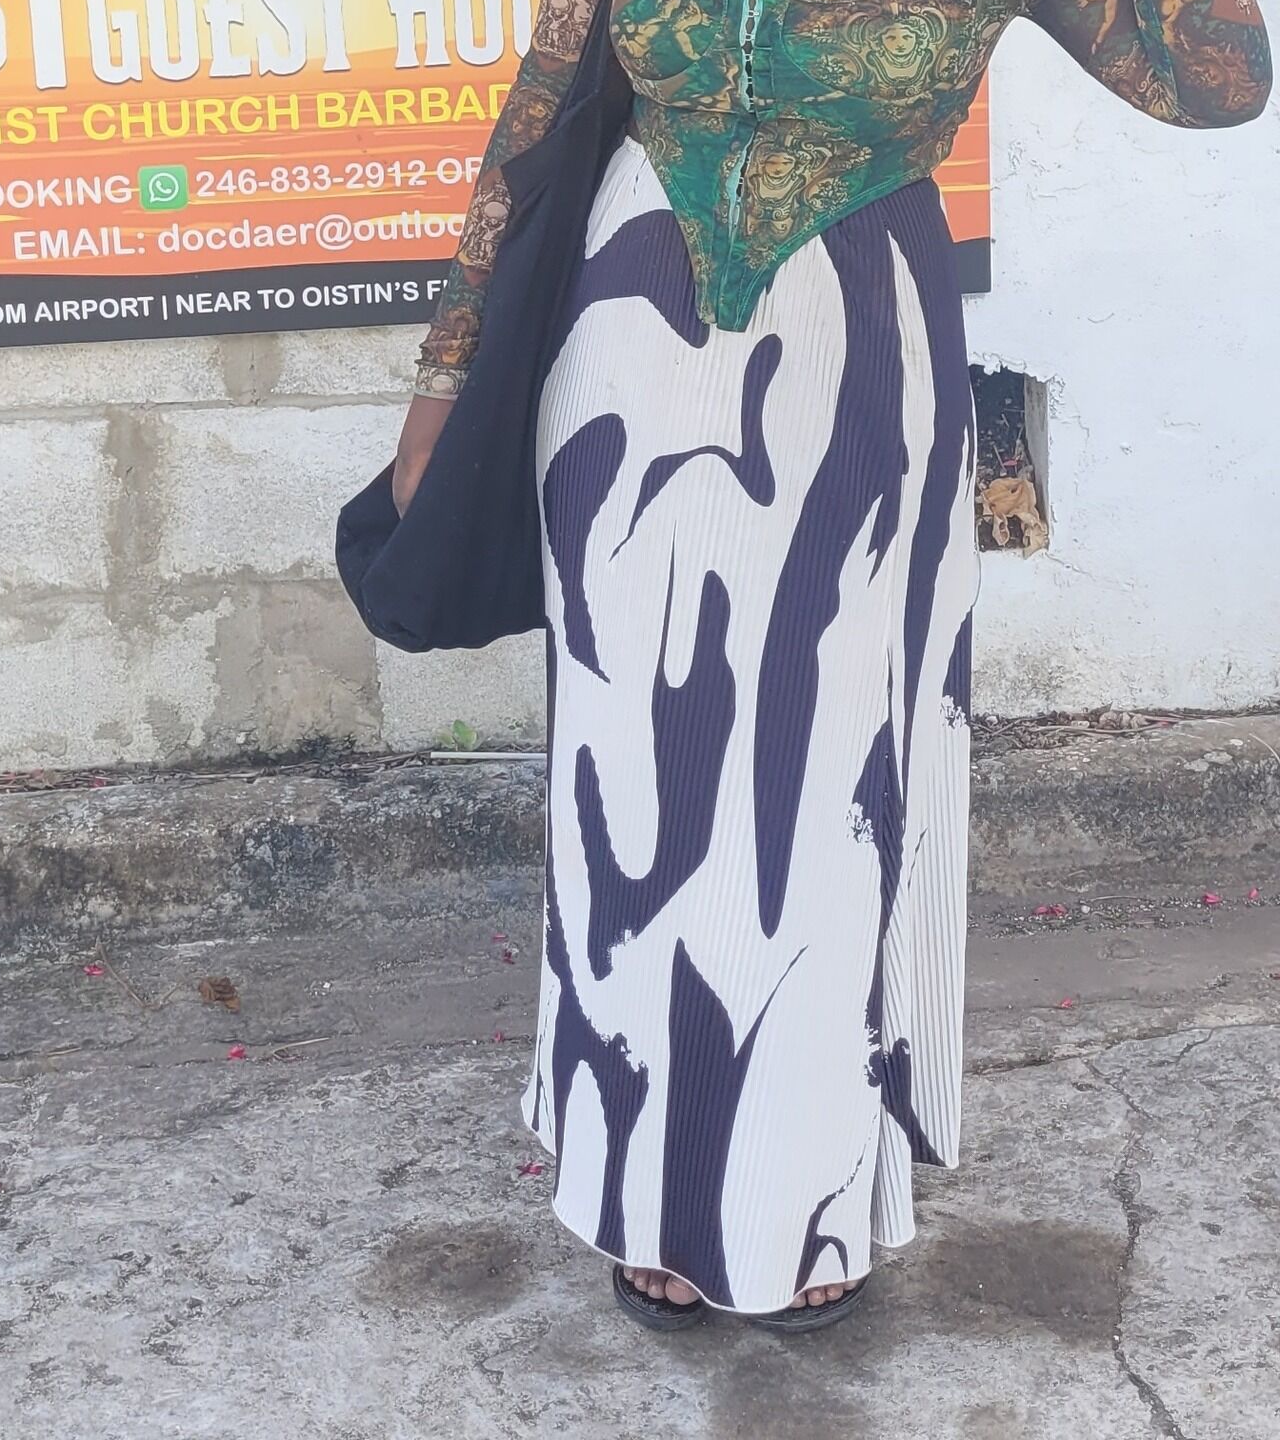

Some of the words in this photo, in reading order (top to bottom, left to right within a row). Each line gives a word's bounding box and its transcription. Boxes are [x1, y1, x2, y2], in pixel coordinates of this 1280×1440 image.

[82, 93, 300, 142] CHURCH
[195, 159, 428, 198] 246-833-2912
[13, 225, 146, 261] EMAIL:
[33, 295, 155, 323] AIRPORT
[176, 290, 252, 315] NEAR
[256, 287, 296, 310] TO
[301, 280, 421, 308] OISTIN’S
